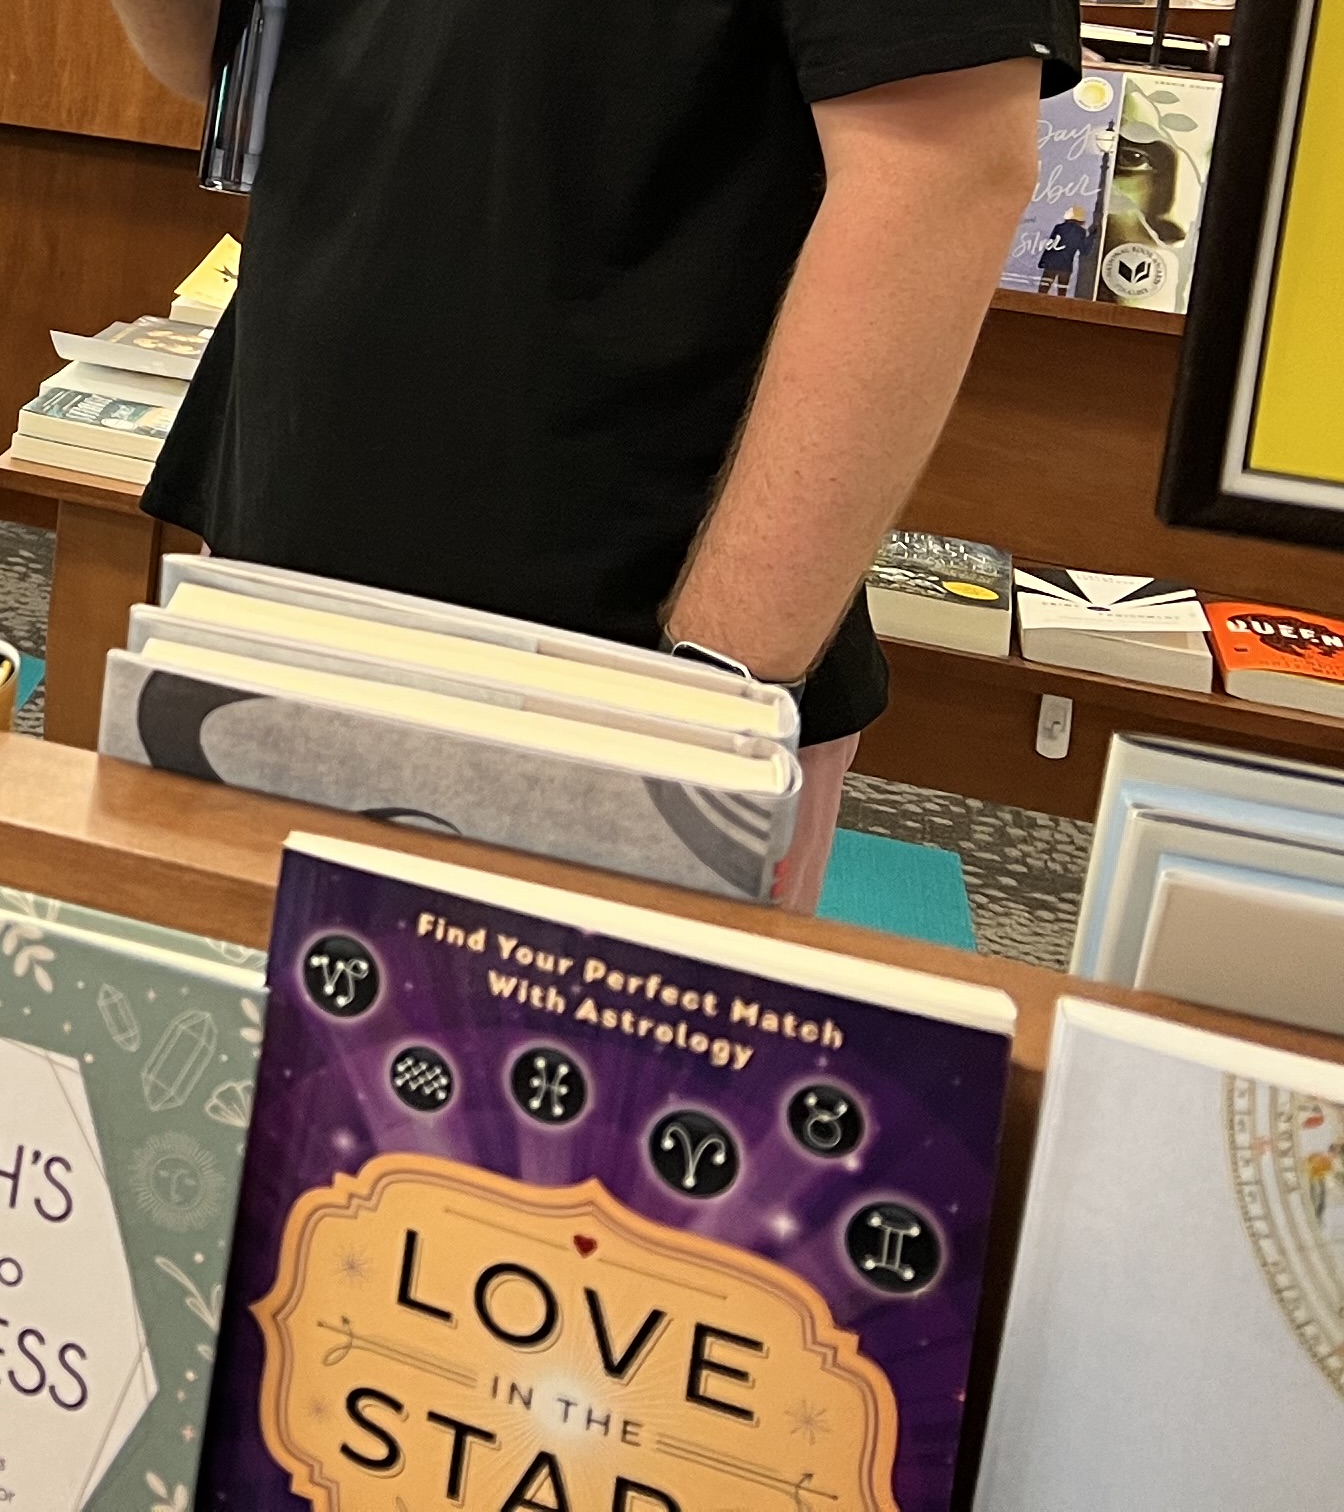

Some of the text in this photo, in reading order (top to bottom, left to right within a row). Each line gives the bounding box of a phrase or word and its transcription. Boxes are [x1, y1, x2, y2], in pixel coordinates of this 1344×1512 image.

[1013, 232, 1067, 258] Silver
[416, 911, 845, 1052] Find Your Perfect Match
[487, 969, 755, 1072] With Astrology
[396, 1228, 768, 1423] LOVE
[489, 1375, 644, 1447] IN THE
